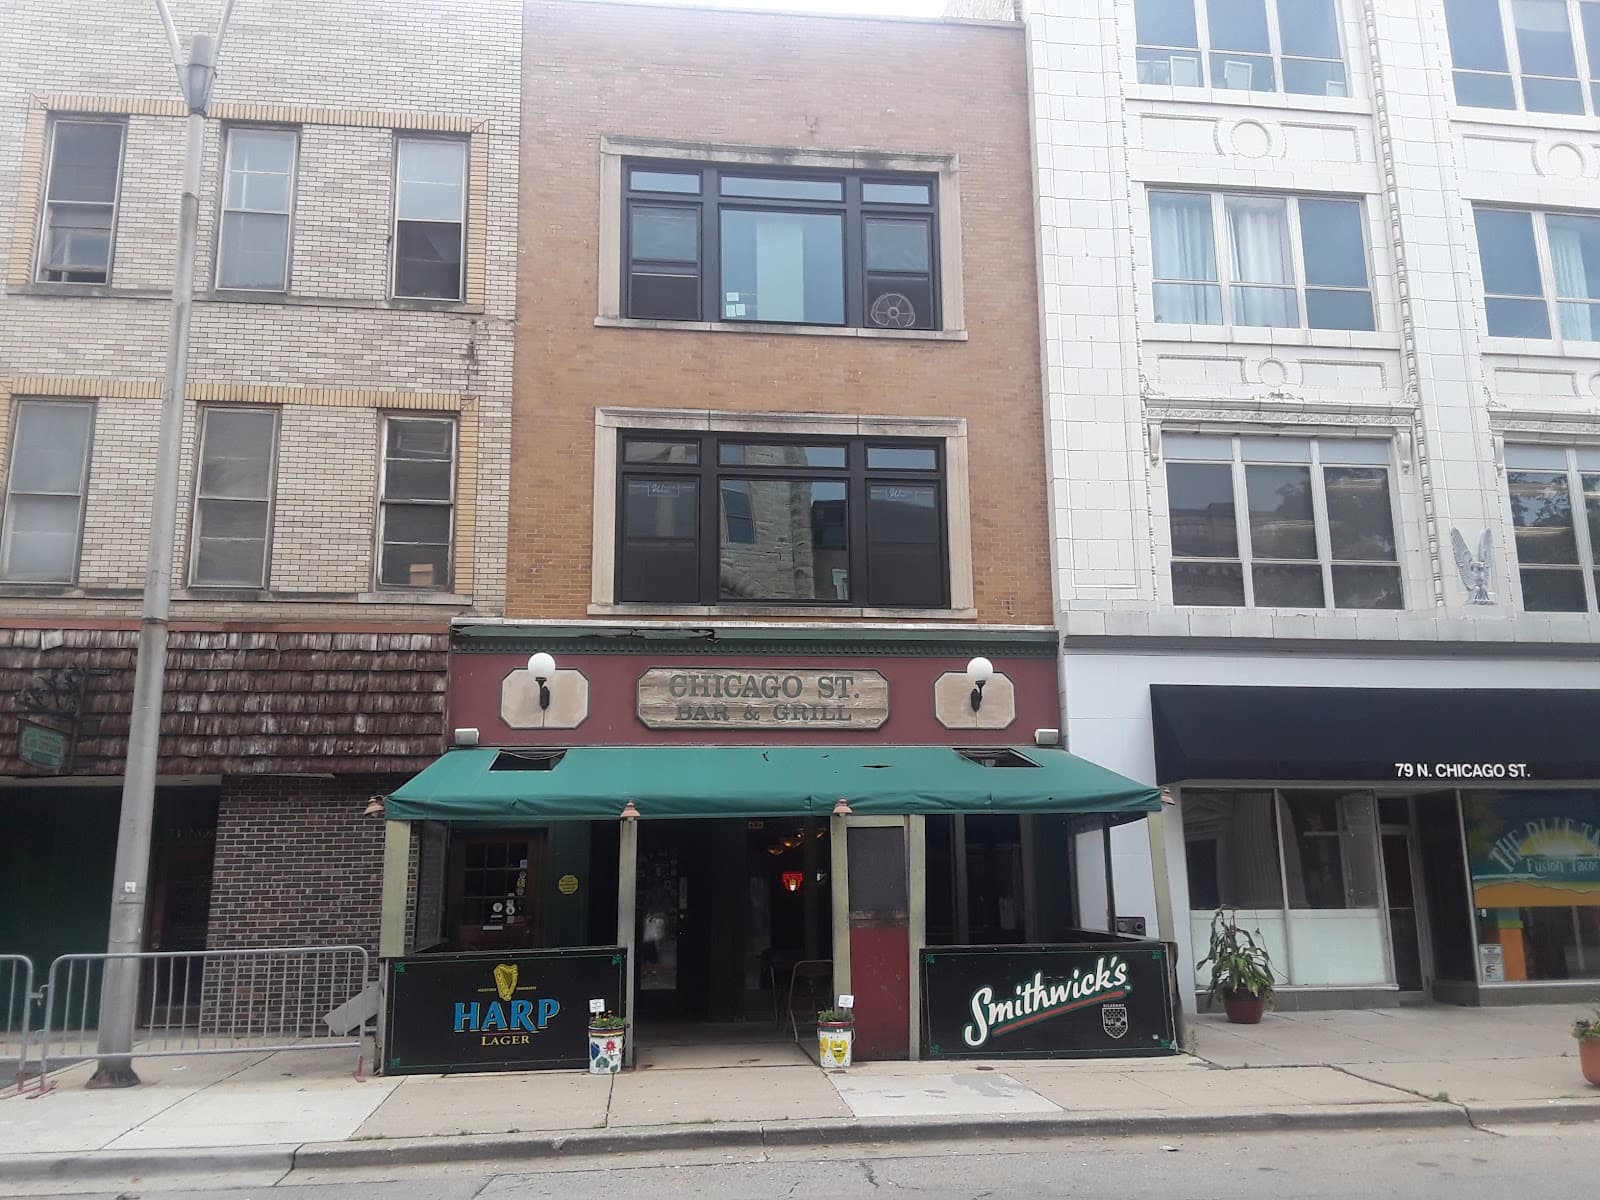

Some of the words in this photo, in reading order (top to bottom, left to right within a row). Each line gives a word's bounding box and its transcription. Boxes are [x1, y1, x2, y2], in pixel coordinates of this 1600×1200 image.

[669, 675, 803, 699] CHICAGO
[817, 675, 860, 699] ST.
[674, 704, 730, 721] BAR
[743, 705, 760, 721] &
[772, 704, 852, 721] GRILL
[1394, 763, 1414, 778] 79
[1416, 763, 1433, 778] N.
[1435, 763, 1505, 778] CHICAGO
[1508, 763, 1531, 778] ST.
[964, 956, 1127, 1046] Smithwick's
[454, 998, 560, 1033] HARP
[481, 1035, 530, 1046] LAGER
